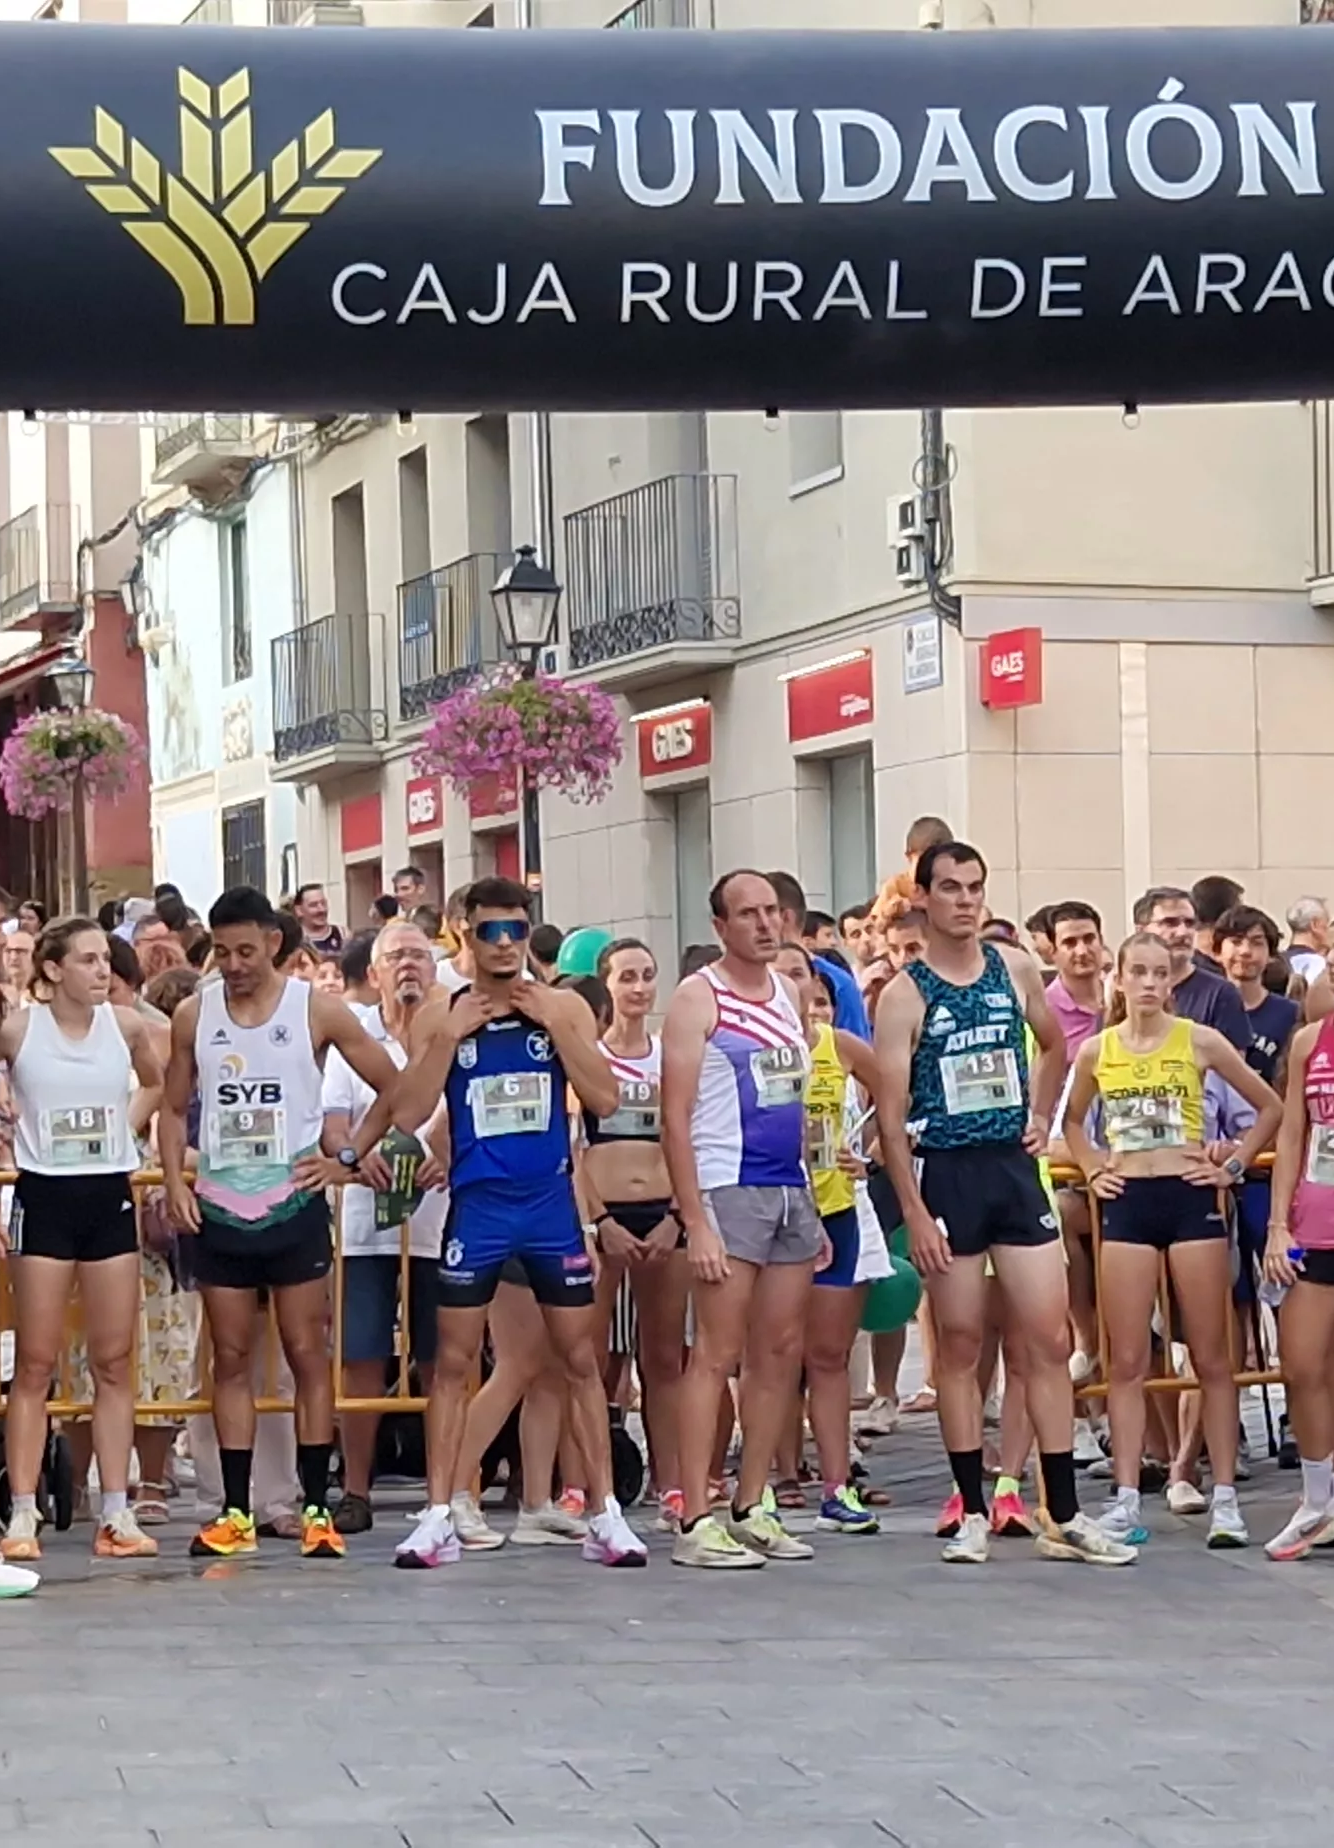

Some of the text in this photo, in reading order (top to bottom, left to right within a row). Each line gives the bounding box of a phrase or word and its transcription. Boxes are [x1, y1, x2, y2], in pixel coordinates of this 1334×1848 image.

[535, 77, 1324, 206] FUNDACIÓN
[331, 262, 576, 324] CAJA
[620, 258, 927, 323] RURAL
[971, 256, 1085, 318] DE
[991, 650, 1024, 677] GAES
[771, 1047, 793, 1069] 10
[967, 1053, 995, 1075] 13
[218, 1083, 282, 1106] SYB
[504, 1077, 520, 1096] 6
[624, 1083, 651, 1101] 19
[64, 1108, 95, 1130] 18
[1128, 1098, 1156, 1118] 26
[238, 1111, 255, 1131] 9
